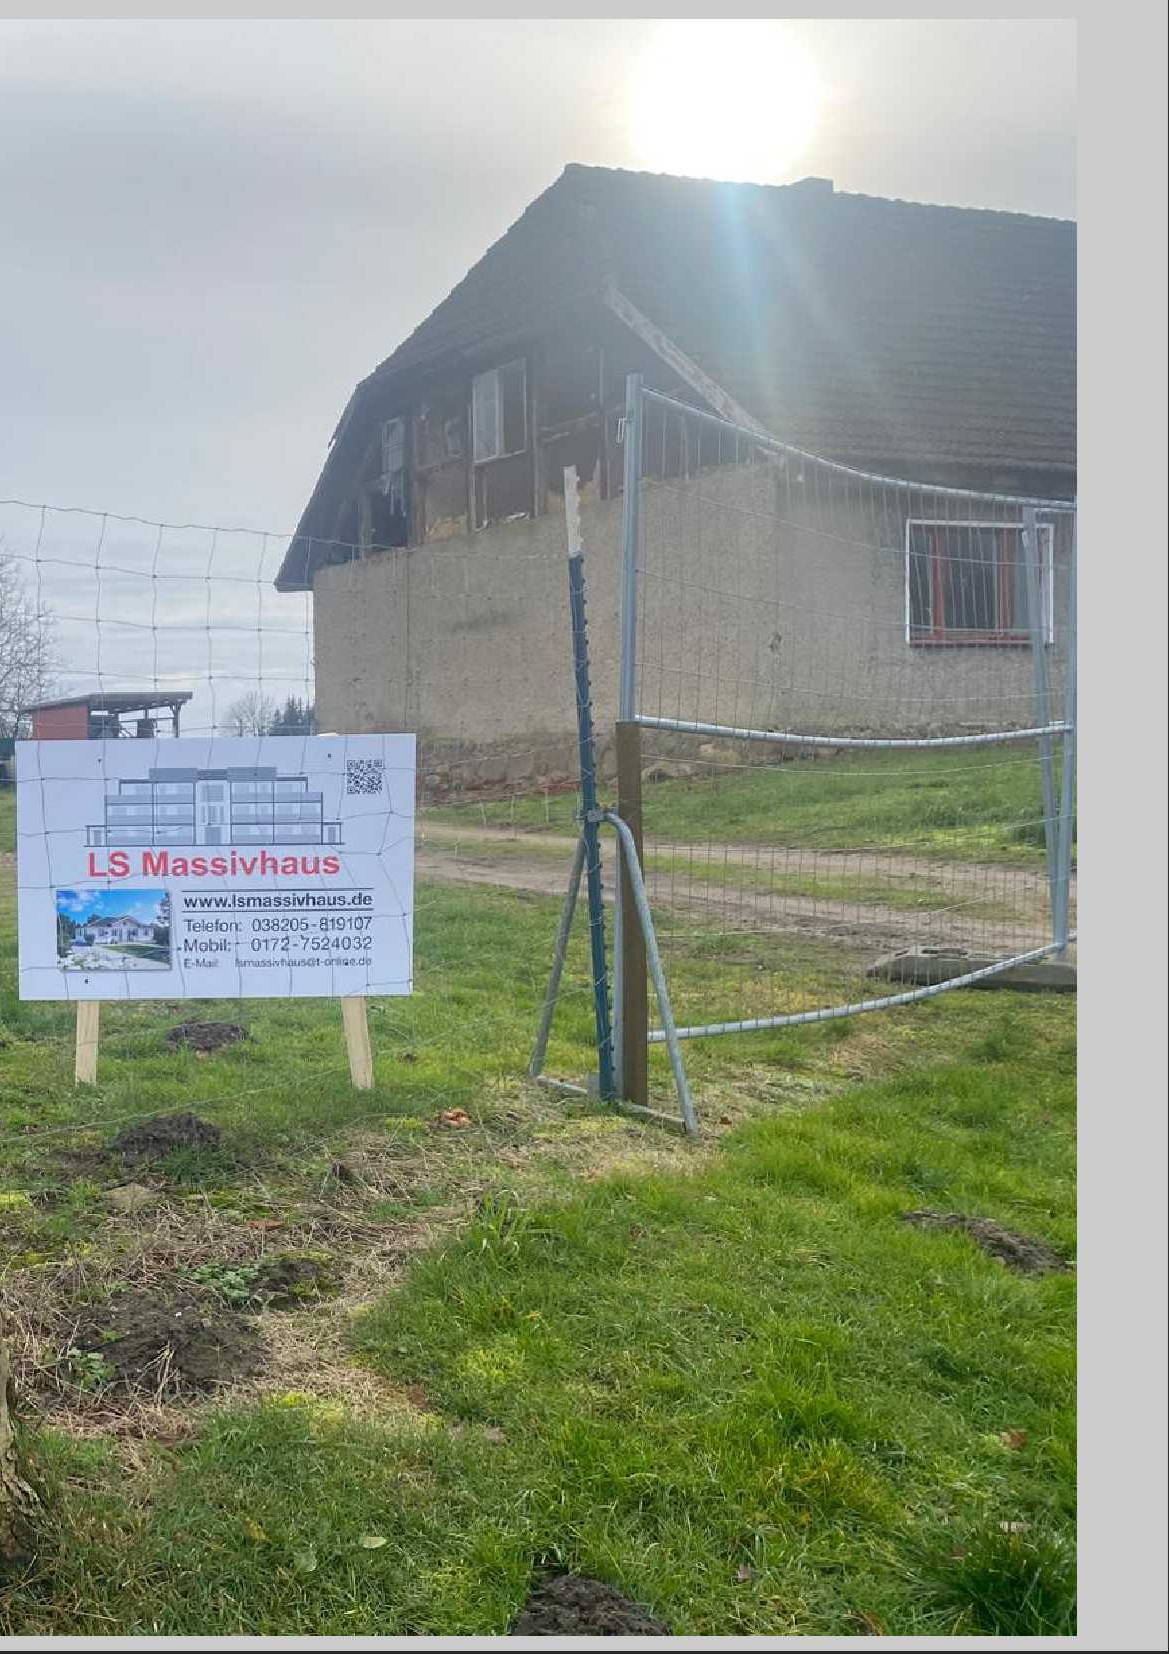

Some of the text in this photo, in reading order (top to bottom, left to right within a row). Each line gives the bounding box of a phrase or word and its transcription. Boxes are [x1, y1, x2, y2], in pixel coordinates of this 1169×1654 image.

[87, 849, 341, 878] LS Massivhaus
[183, 892, 373, 909] www.lsmassivhaus.de
[182, 918, 243, 933] Telefon:
[183, 938, 232, 952] Mobil:
